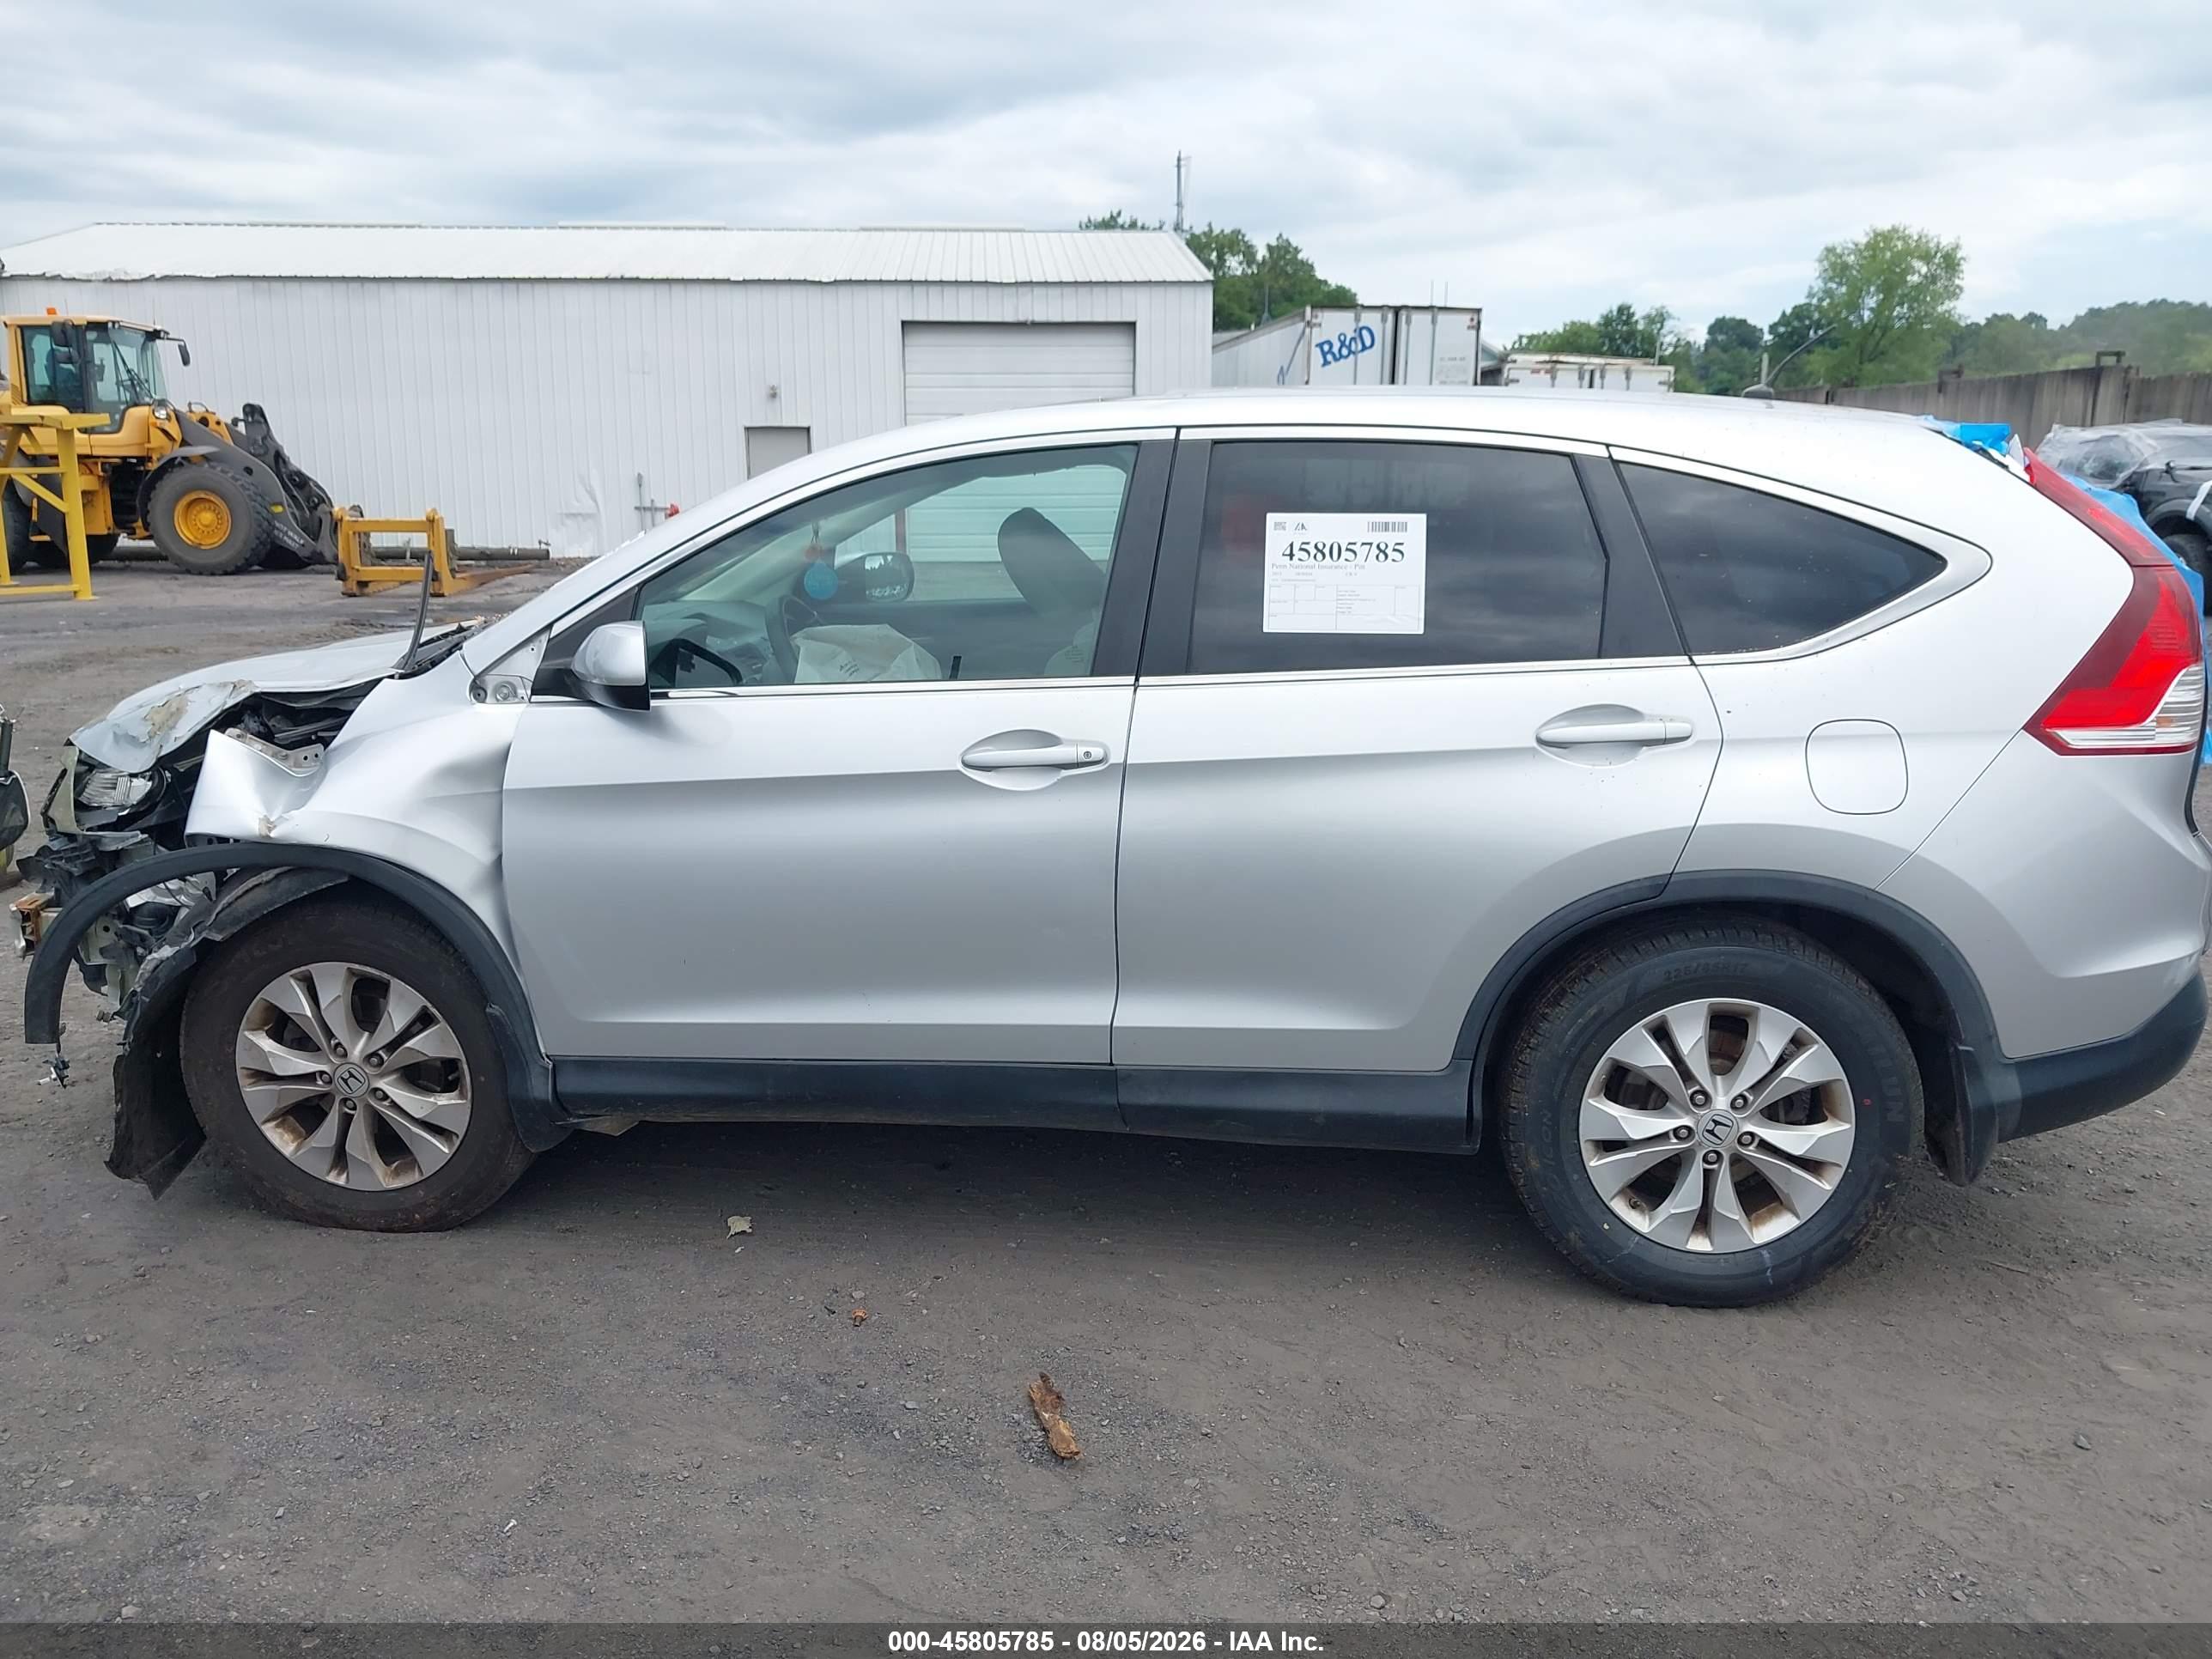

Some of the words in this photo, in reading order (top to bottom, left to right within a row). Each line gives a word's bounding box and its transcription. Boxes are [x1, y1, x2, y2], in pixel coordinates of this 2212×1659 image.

[1315, 325, 1376, 368] R&D
[1281, 540, 1405, 562] 45805785
[1317, 562, 1348, 571] Insurance
